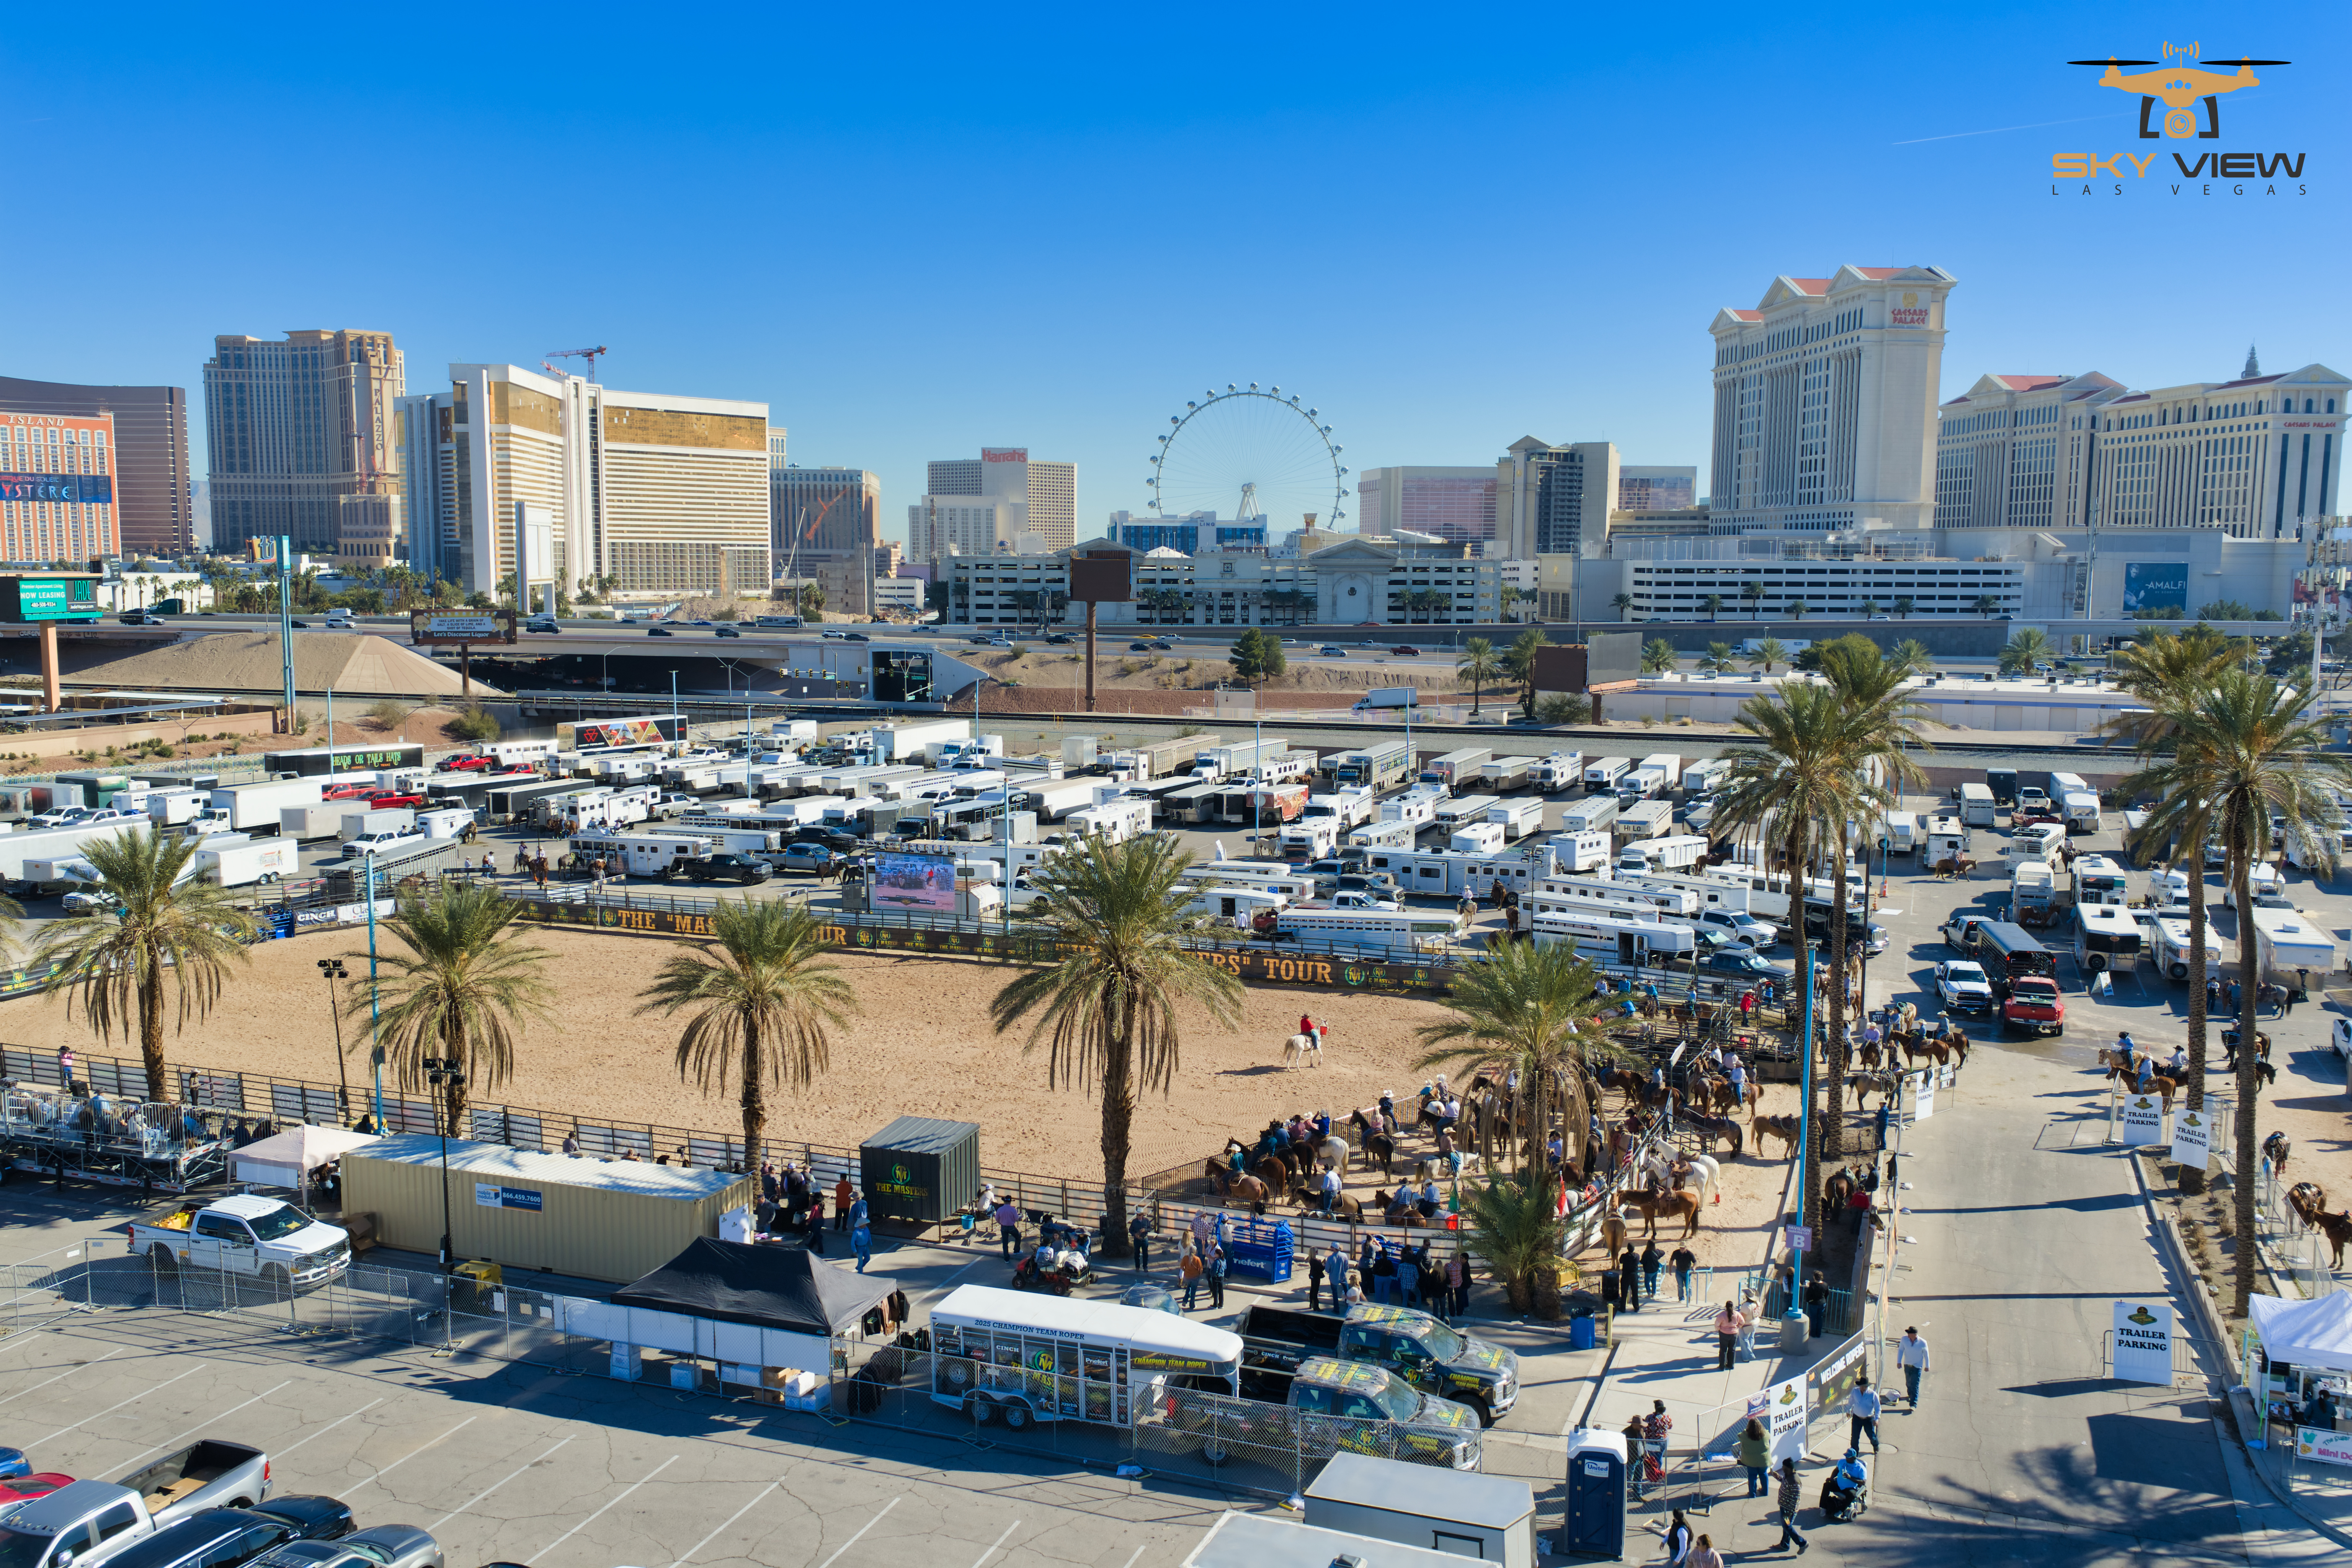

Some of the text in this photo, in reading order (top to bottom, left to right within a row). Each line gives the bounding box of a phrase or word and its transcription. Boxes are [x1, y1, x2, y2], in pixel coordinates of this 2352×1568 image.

[1891, 308, 1928, 317] CAESARS
[1893, 316, 1925, 325] PALACE
[8, 415, 64, 427] ISLAND
[374, 388, 383, 451] PALAZZO
[73, 580, 92, 601] JADE
[2145, 581, 2185, 589] AMALFI
[333, 751, 401, 770] HEADS OR TAILS HATS
[352, 903, 380, 915] Clasic
[297, 910, 335, 922] CINCH
[618, 910, 656, 930] THE
[1263, 957, 1333, 983] TOUR
[1918, 1093, 1933, 1101] PARKING
[2127, 1111, 2159, 1119] TRAILER
[2126, 1119, 2159, 1127] PARKING
[2177, 1126, 2207, 1139] TRAILER
[2176, 1134, 2207, 1147] PARKING
[875, 1182, 928, 1196] THE MASTERS
[502, 1192, 541, 1202] 866.459.7600
[1793, 1234, 1805, 1248] B
[975, 1319, 1085, 1340] 2025 CHAMPION TEAM ROPER
[2119, 1327, 2166, 1340] TRAILER
[996, 1344, 1019, 1352] CINCH
[2117, 1339, 2167, 1352] PARKING
[1085, 1357, 1109, 1365] Priefert
[1261, 1351, 1280, 1359] CINCH
[1134, 1357, 1207, 1369] CHAMPION TEAM ROPER
[1820, 1341, 1865, 1385] WELCOME ROPERS
[1449, 1372, 1480, 1383] CHAMPION
[1774, 1405, 1803, 1424] TRAILER
[1773, 1417, 1804, 1437] PARKING
[2317, 1447, 2339, 1458] Mini
[1587, 1463, 1609, 1471] United
